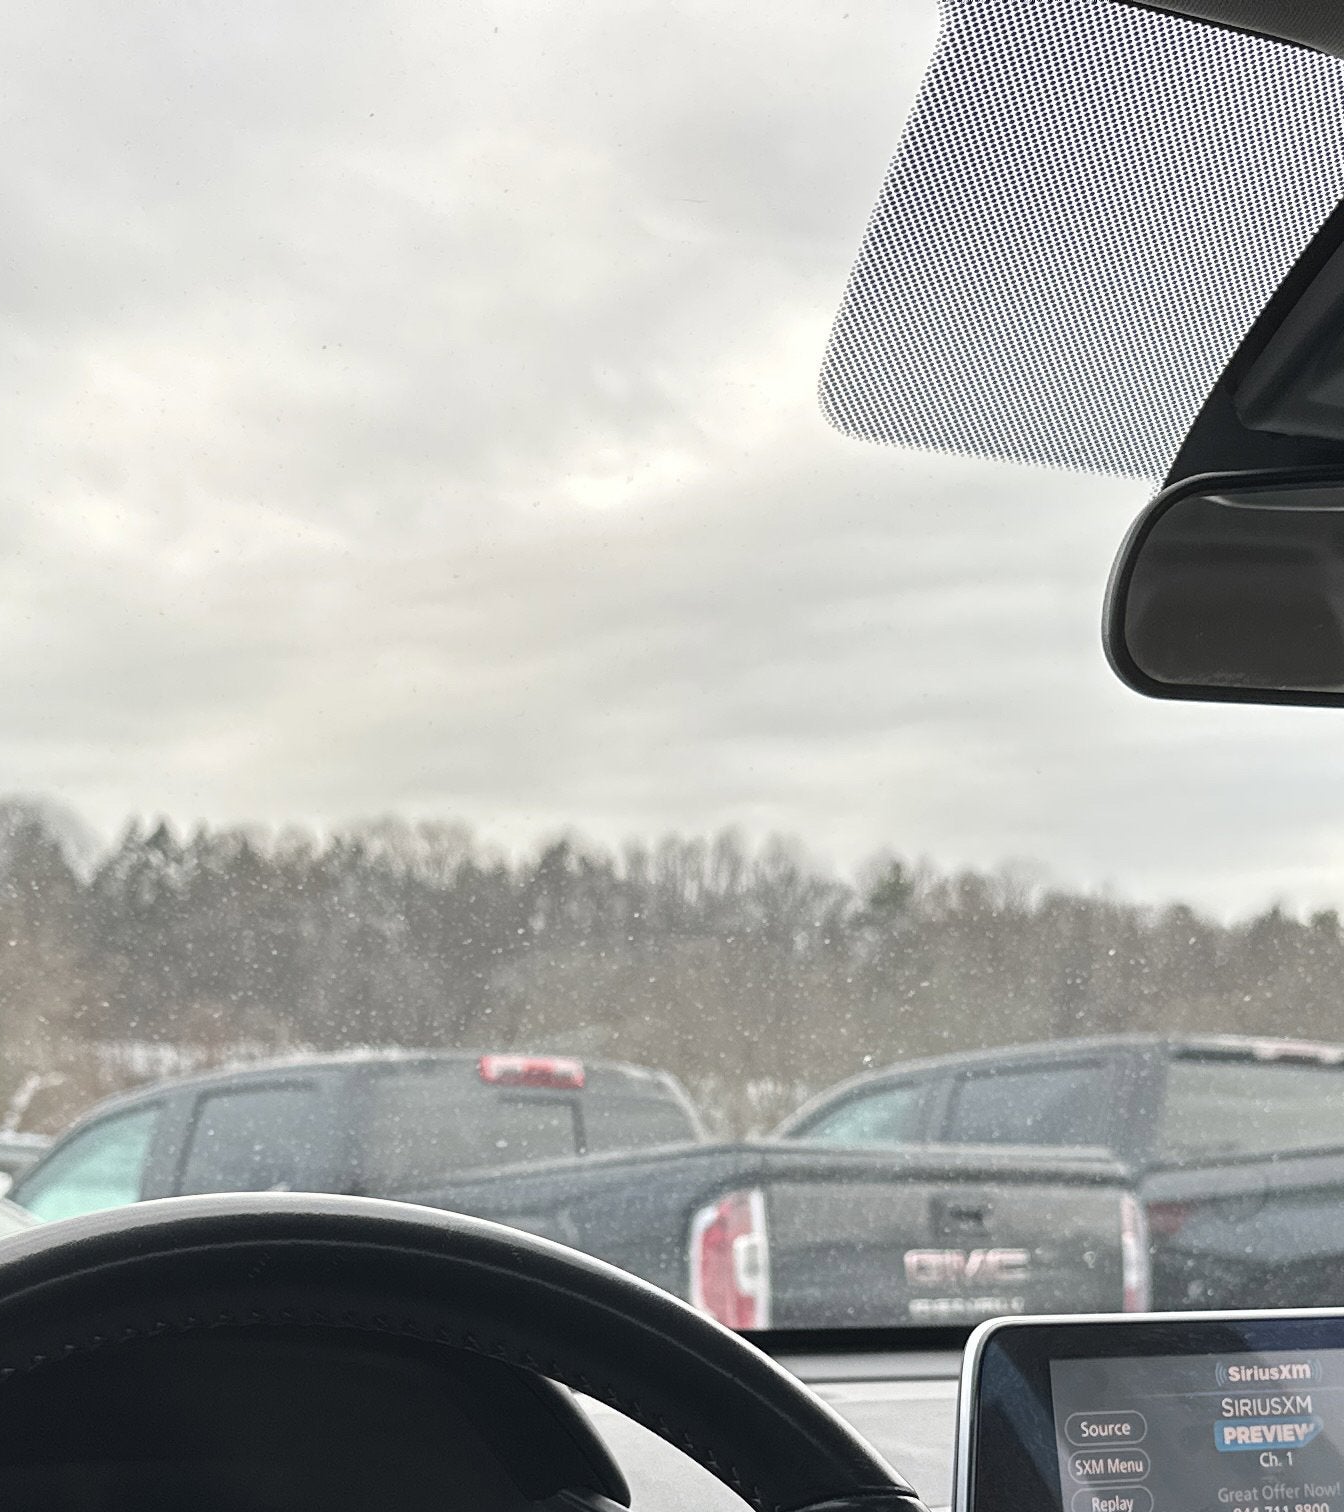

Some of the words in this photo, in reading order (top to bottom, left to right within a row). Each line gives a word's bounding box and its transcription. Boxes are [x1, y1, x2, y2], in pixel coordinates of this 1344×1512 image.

[1221, 1395, 1313, 1417] SIRIUSXM
[1080, 1421, 1131, 1438] Source
[1223, 1424, 1315, 1445] PREVIEW
[1074, 1459, 1104, 1476] SXM
[1107, 1457, 1144, 1474] Menu
[1259, 1452, 1283, 1468] Ch.
[1286, 1451, 1294, 1466] 1
[1217, 1486, 1258, 1503] Great
[1261, 1484, 1300, 1501] Offer
[1304, 1482, 1341, 1499] Now!
